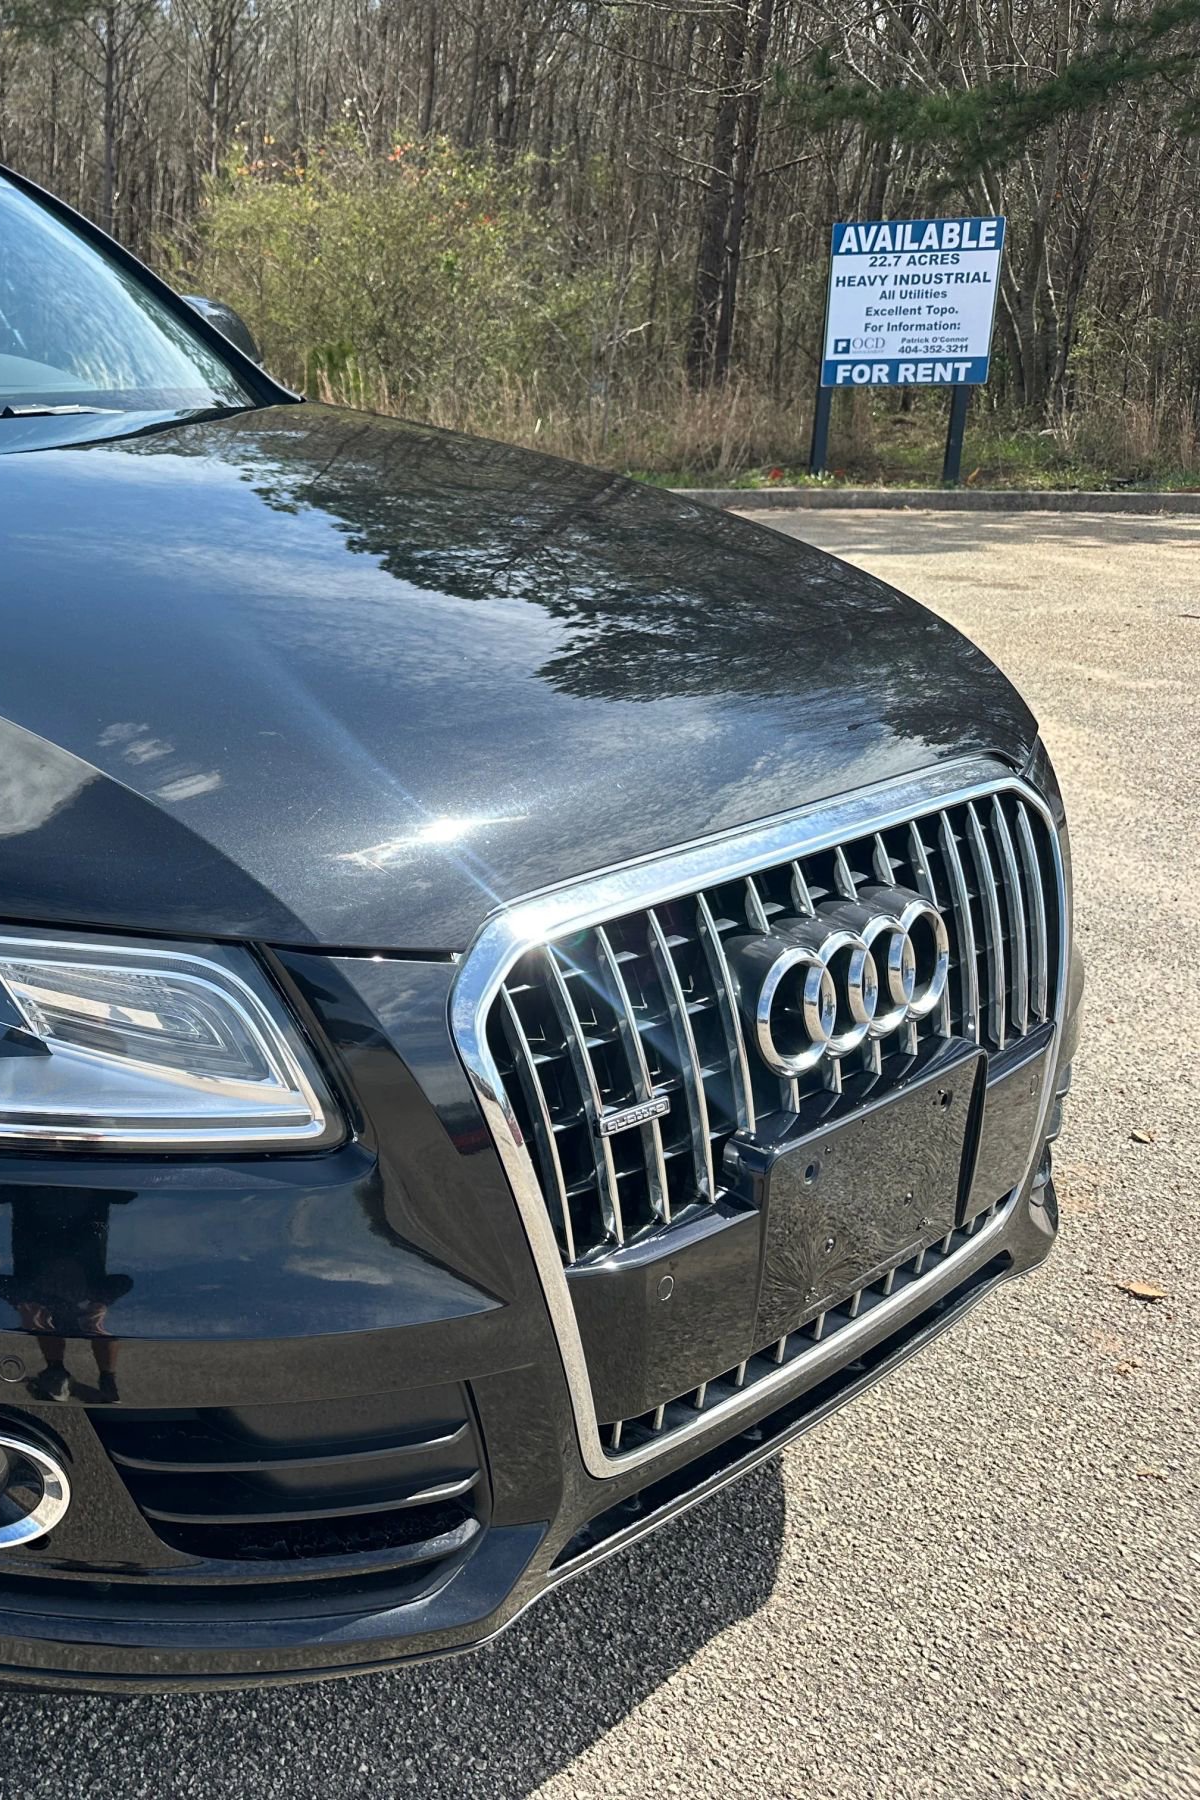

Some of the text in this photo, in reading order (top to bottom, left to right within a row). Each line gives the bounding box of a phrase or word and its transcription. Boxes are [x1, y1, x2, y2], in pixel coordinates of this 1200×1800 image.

[839, 221, 998, 253] AVAILABLE
[868, 253, 960, 267] 22.7 ACRES
[835, 271, 991, 287] HEAVY INDUSTRIAL
[879, 289, 947, 300] All Utilities
[865, 305, 959, 317] Excellent Topo.
[864, 321, 961, 333] For Information:
[852, 337, 886, 350] OCD
[901, 336, 929, 344] Patrick
[898, 344, 968, 354] 404-352-3211
[836, 362, 972, 384] FOR RENT
[606, 1102, 667, 1131] quattro
